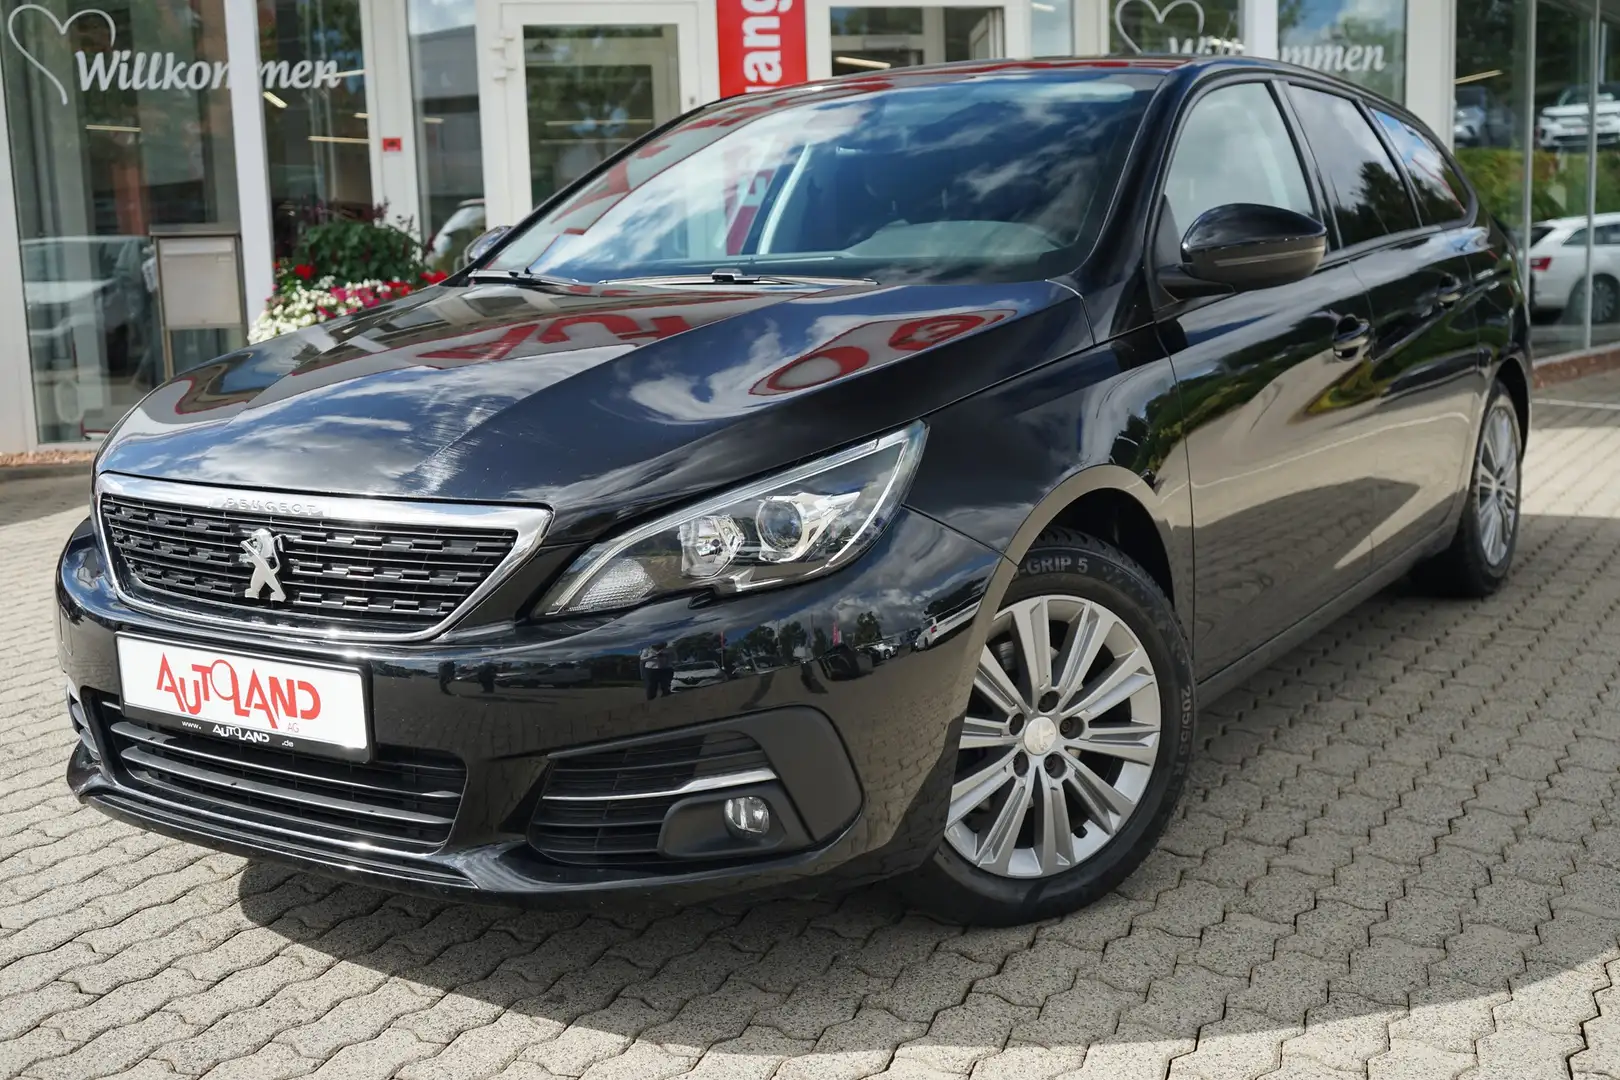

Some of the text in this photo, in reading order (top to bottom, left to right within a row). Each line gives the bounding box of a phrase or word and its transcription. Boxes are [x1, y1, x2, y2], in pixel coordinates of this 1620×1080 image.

[741, 0, 793, 93] an
[226, 497, 316, 515] PEUGEOT
[1015, 555, 1088, 578] -GRIP 5
[181, 720, 202, 730] www.
[281, 740, 294, 748] .de
[287, 722, 300, 734] AG
